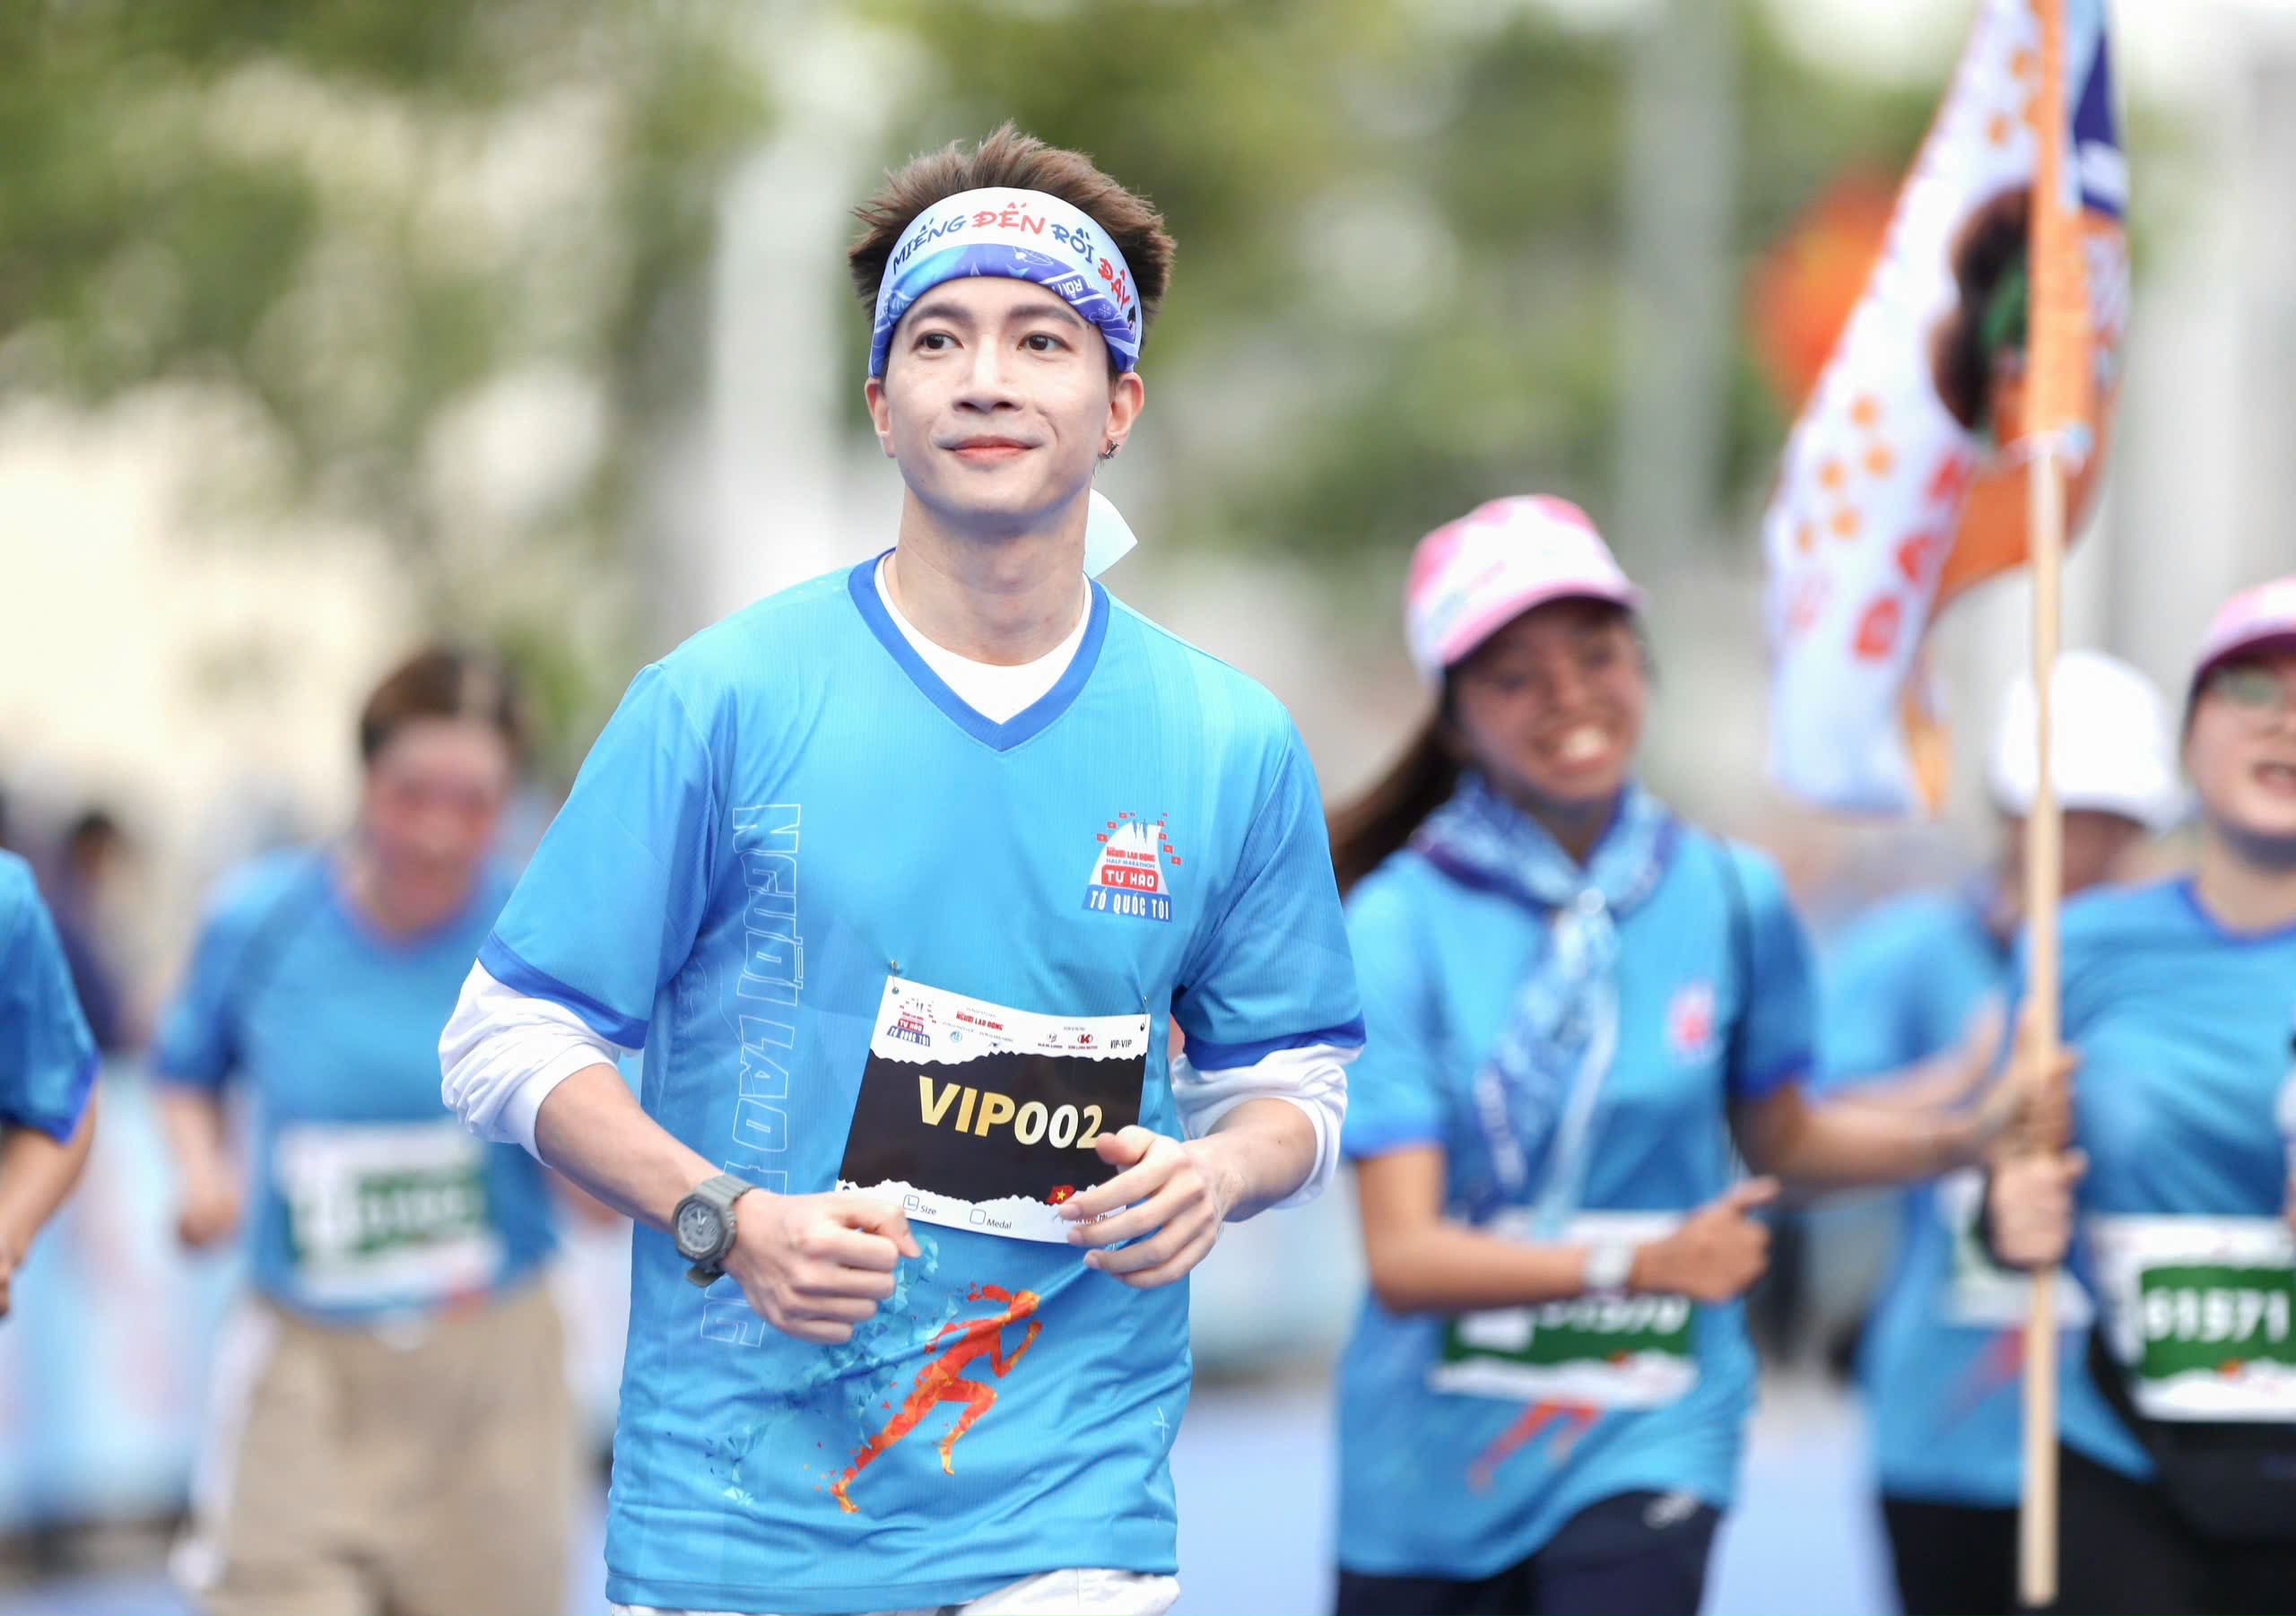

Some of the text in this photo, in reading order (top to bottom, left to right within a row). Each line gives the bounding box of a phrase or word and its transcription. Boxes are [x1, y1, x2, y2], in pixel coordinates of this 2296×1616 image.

[892, 215, 966, 275] MIẾNG
[971, 202, 1047, 235] ĐẾN
[1051, 223, 1095, 264] RỒI
[1105, 869, 1155, 888] TỰ HÀO
[1113, 891, 1146, 917] QUỐC
[732, 1014, 795, 1152] LAO
[918, 1074, 1103, 1149] VIP002
[920, 1204, 937, 1215] Size
[987, 1218, 1013, 1229] Medal
